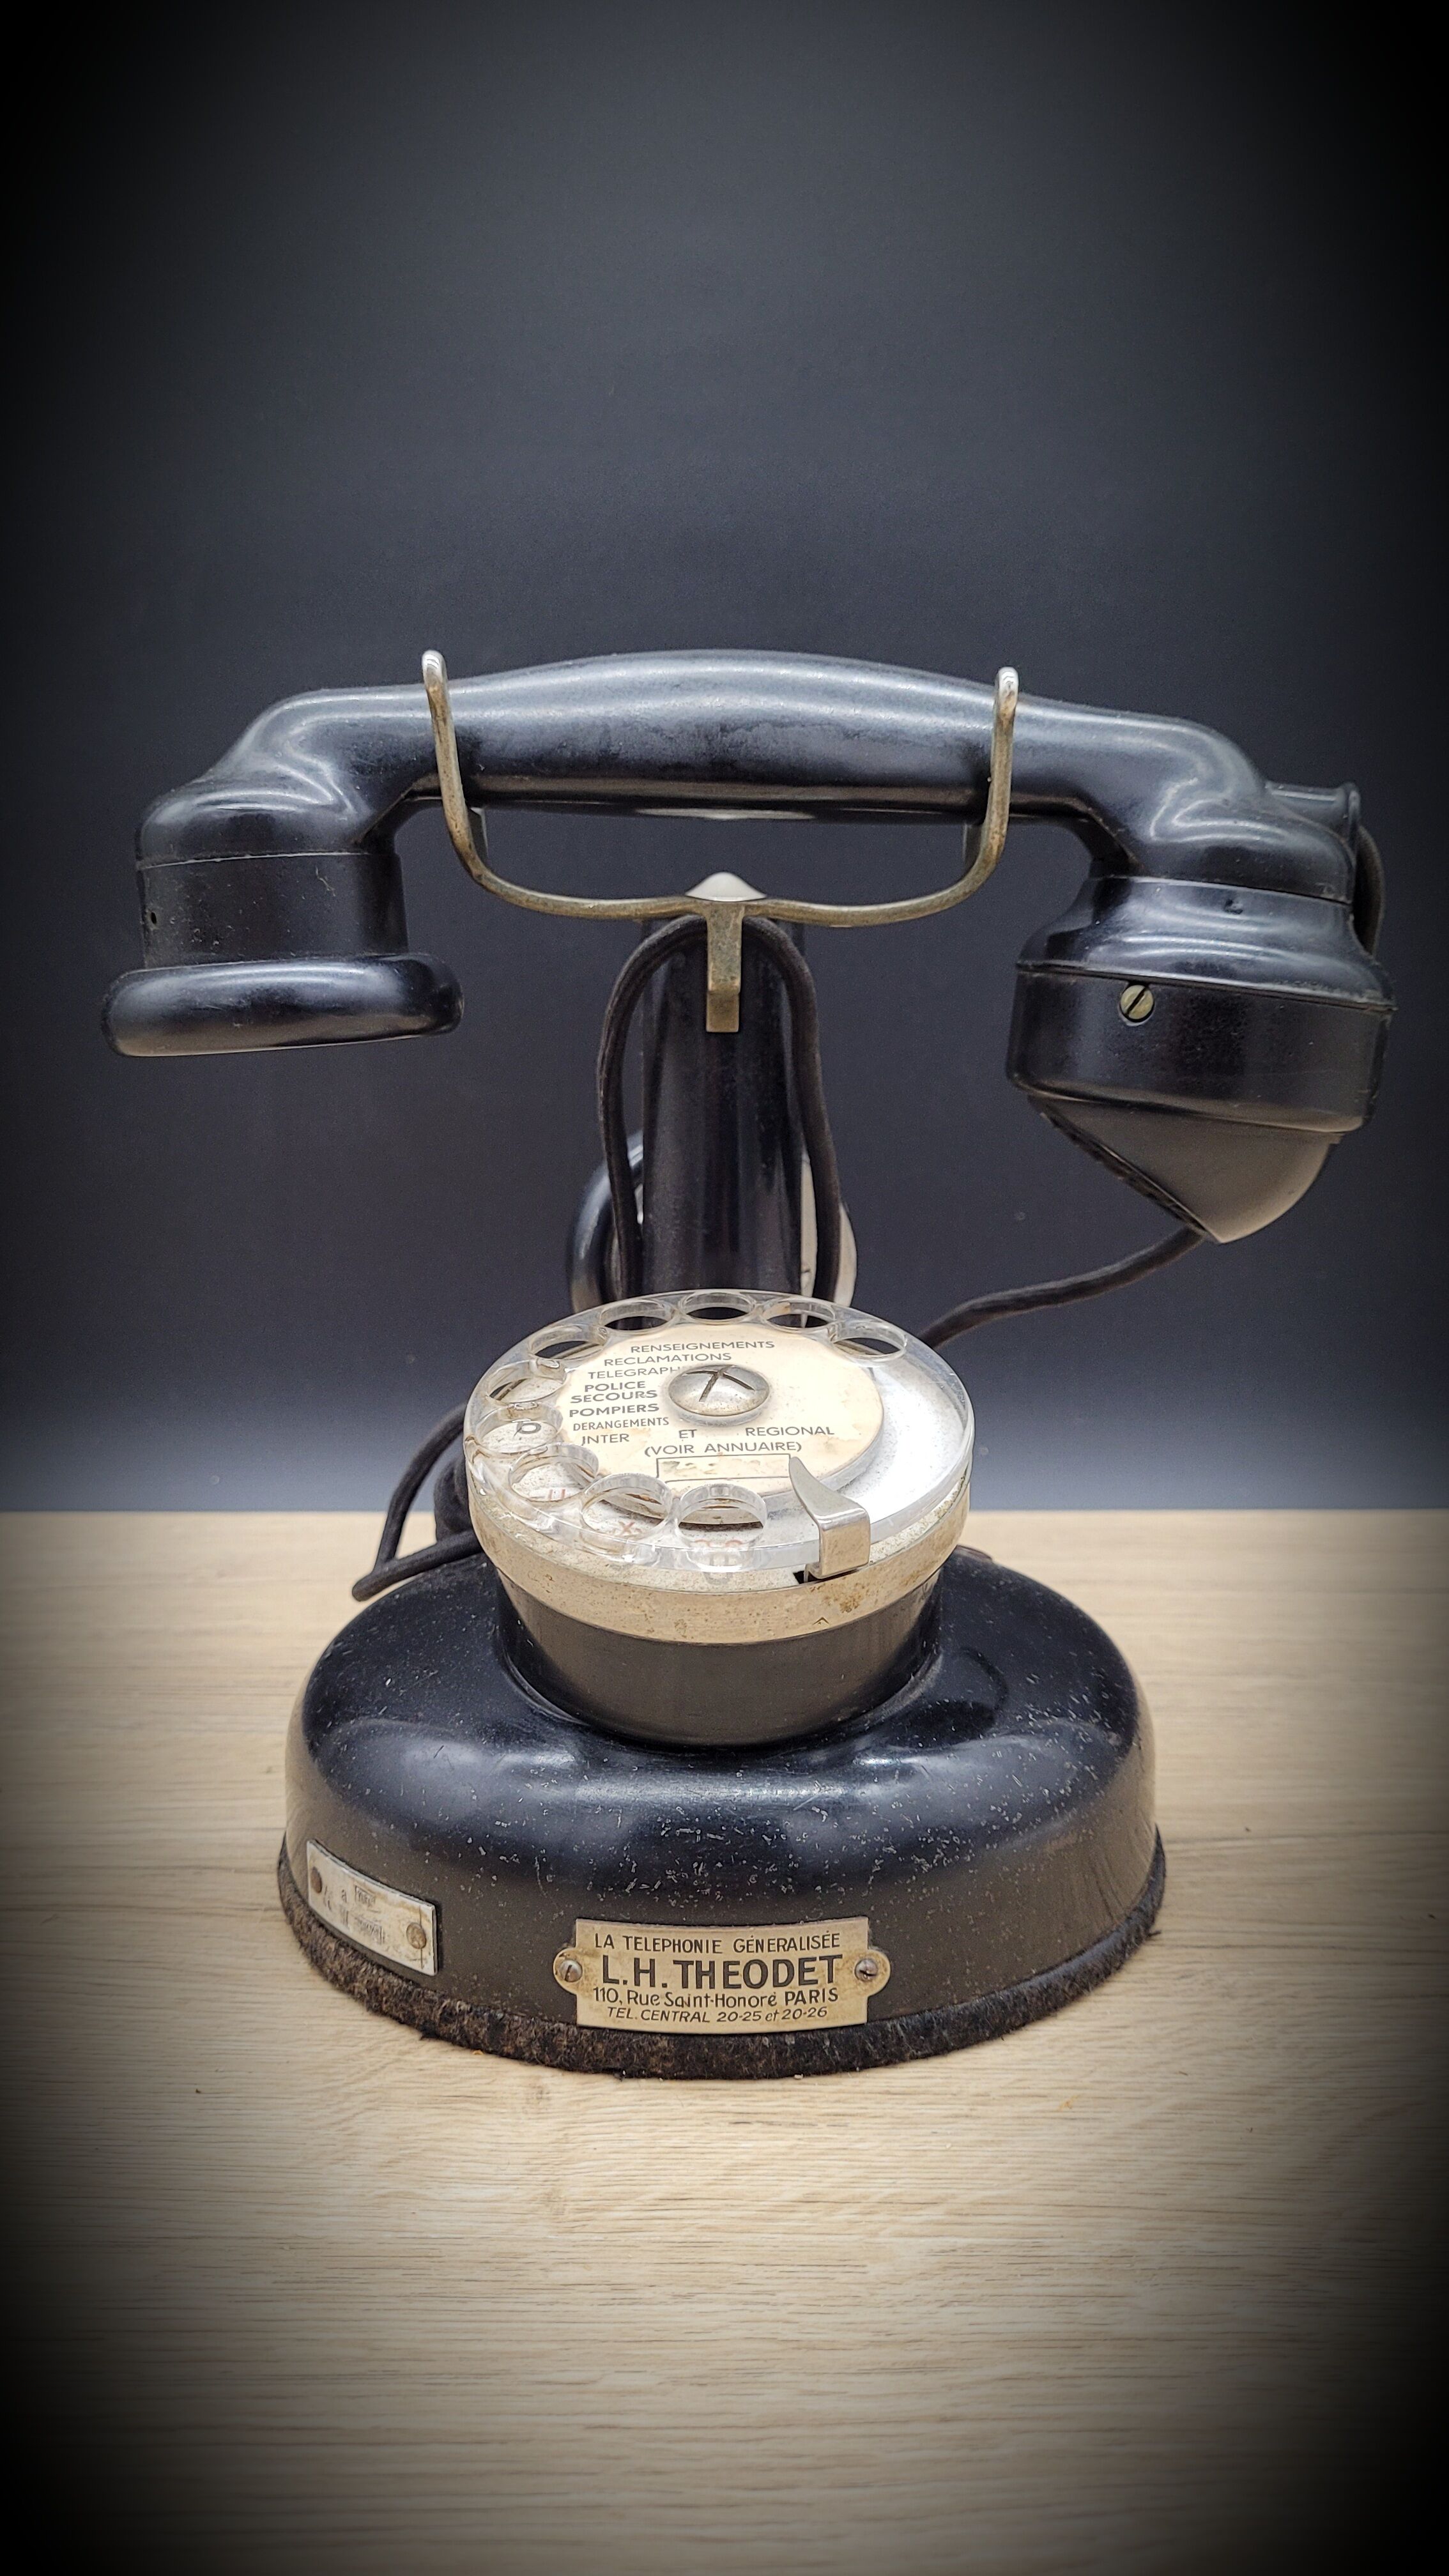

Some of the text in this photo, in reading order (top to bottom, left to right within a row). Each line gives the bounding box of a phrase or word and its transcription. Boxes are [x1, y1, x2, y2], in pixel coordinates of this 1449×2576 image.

[631, 1341, 775, 1353] RENSEIGNEMENTS
[604, 1353, 732, 1367] RECLAMATIONS
[588, 1367, 681, 1379] TELEGRAPH
[585, 1381, 646, 1392] POLICE
[570, 1390, 658, 1404] SECOURS
[569, 1403, 659, 1418] POMPIERS
[573, 1417, 670, 1431] DERANGEMENTS
[678, 1429, 698, 1439] ET
[745, 1426, 835, 1436] REGIONAL
[644, 1441, 802, 1457] (VOIR ANNUAIRE)
[595, 1933, 615, 1949] LA
[622, 1935, 723, 1954] TELEPHONIE
[602, 1954, 843, 1989] L.H. THEODET
[593, 1986, 623, 2005] 110,
[627, 1990, 660, 2005] Rue
[785, 1988, 838, 2005] PARIS
[608, 2007, 828, 2023] TEL. CENTRAL 20-25 et 20-26
